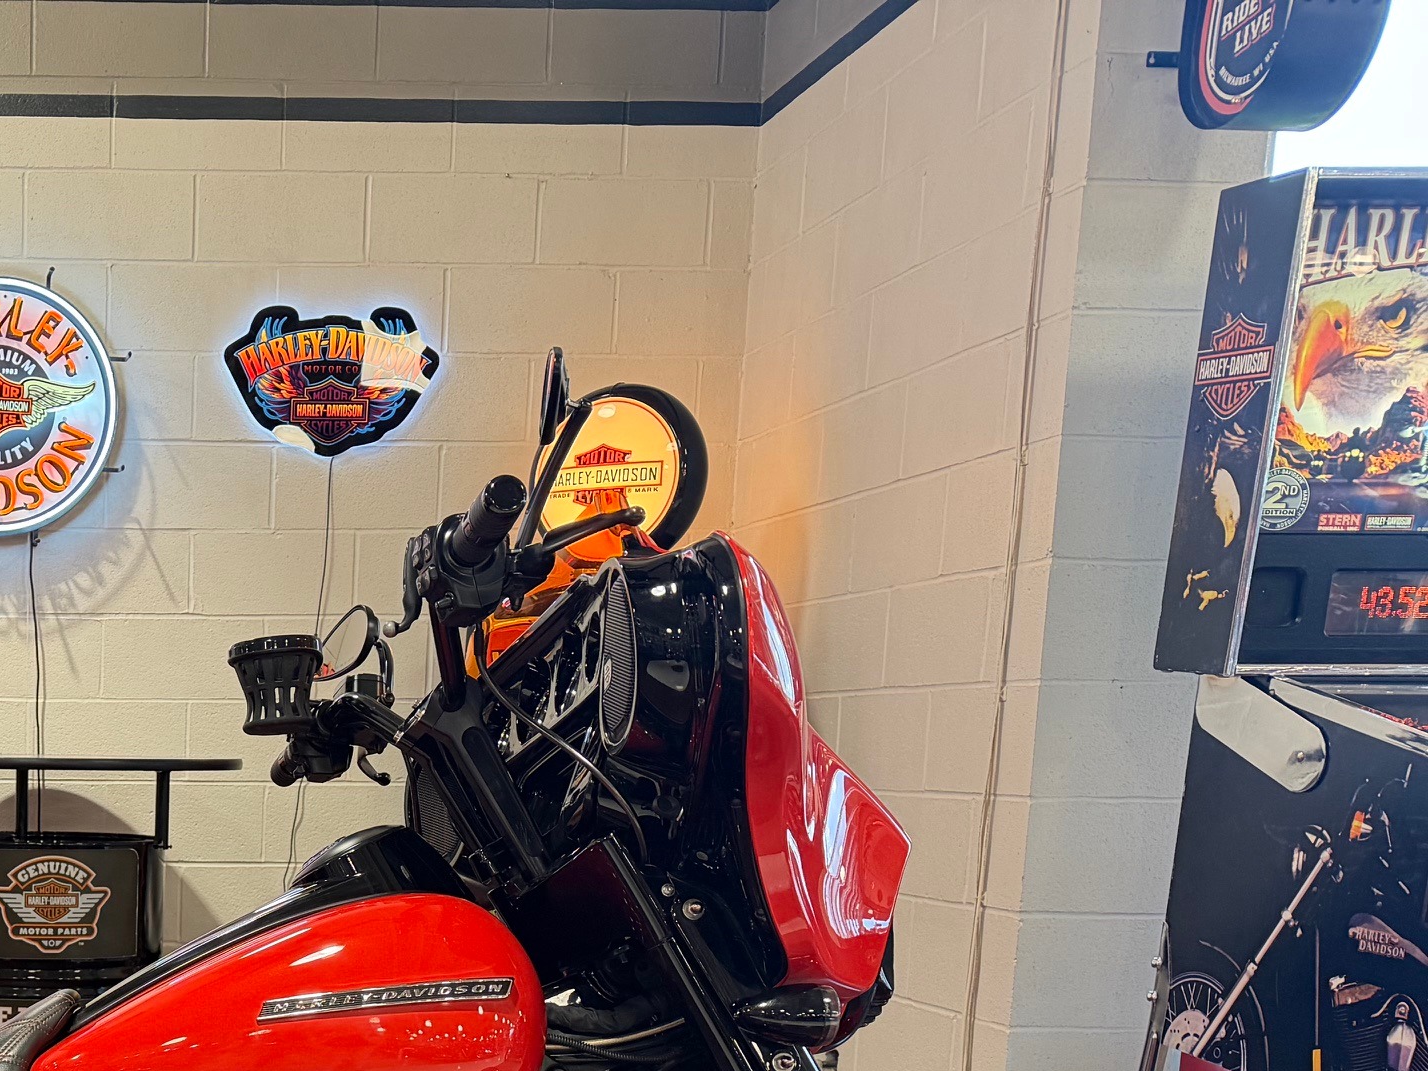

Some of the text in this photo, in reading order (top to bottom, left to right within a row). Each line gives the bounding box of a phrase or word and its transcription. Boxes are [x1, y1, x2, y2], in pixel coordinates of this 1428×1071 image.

[1234, 7, 1272, 53] LIVE
[1218, 65, 1251, 86] MILWAUKEE
[1302, 205, 1428, 283] HARL
[1218, 326, 1255, 351] MOTOR
[236, 325, 429, 391] HARLEY-DAVIDSON
[1199, 351, 1269, 380] HARLEY-DAVIDSON
[2, 367, 18, 375] 1903
[304, 364, 359, 374] MOTOR CO
[313, 386, 348, 401] MOTOR
[1212, 381, 1249, 409] CYCLES
[296, 402, 364, 418] HARLEY-DAVIDSON
[311, 420, 347, 436] CYCLES
[581, 447, 624, 465] MOTOR
[1262, 481, 1298, 509] 2ND
[1319, 514, 1360, 526] STERN
[1367, 516, 1413, 525] HARLEY-DAVIDSON
[17, 861, 88, 883] GENUINE
[39, 884, 65, 893] MOTOR
[28, 896, 76, 905] HARLEY-DAVIDSON
[39, 908, 65, 918] CYCLES
[19, 927, 88, 935] MOTOR PARTS
[1355, 927, 1392, 944] HARLEY
[1358, 939, 1406, 958] DAVIDSON
[272, 984, 503, 1014] HARLEY-DAVIDSON
